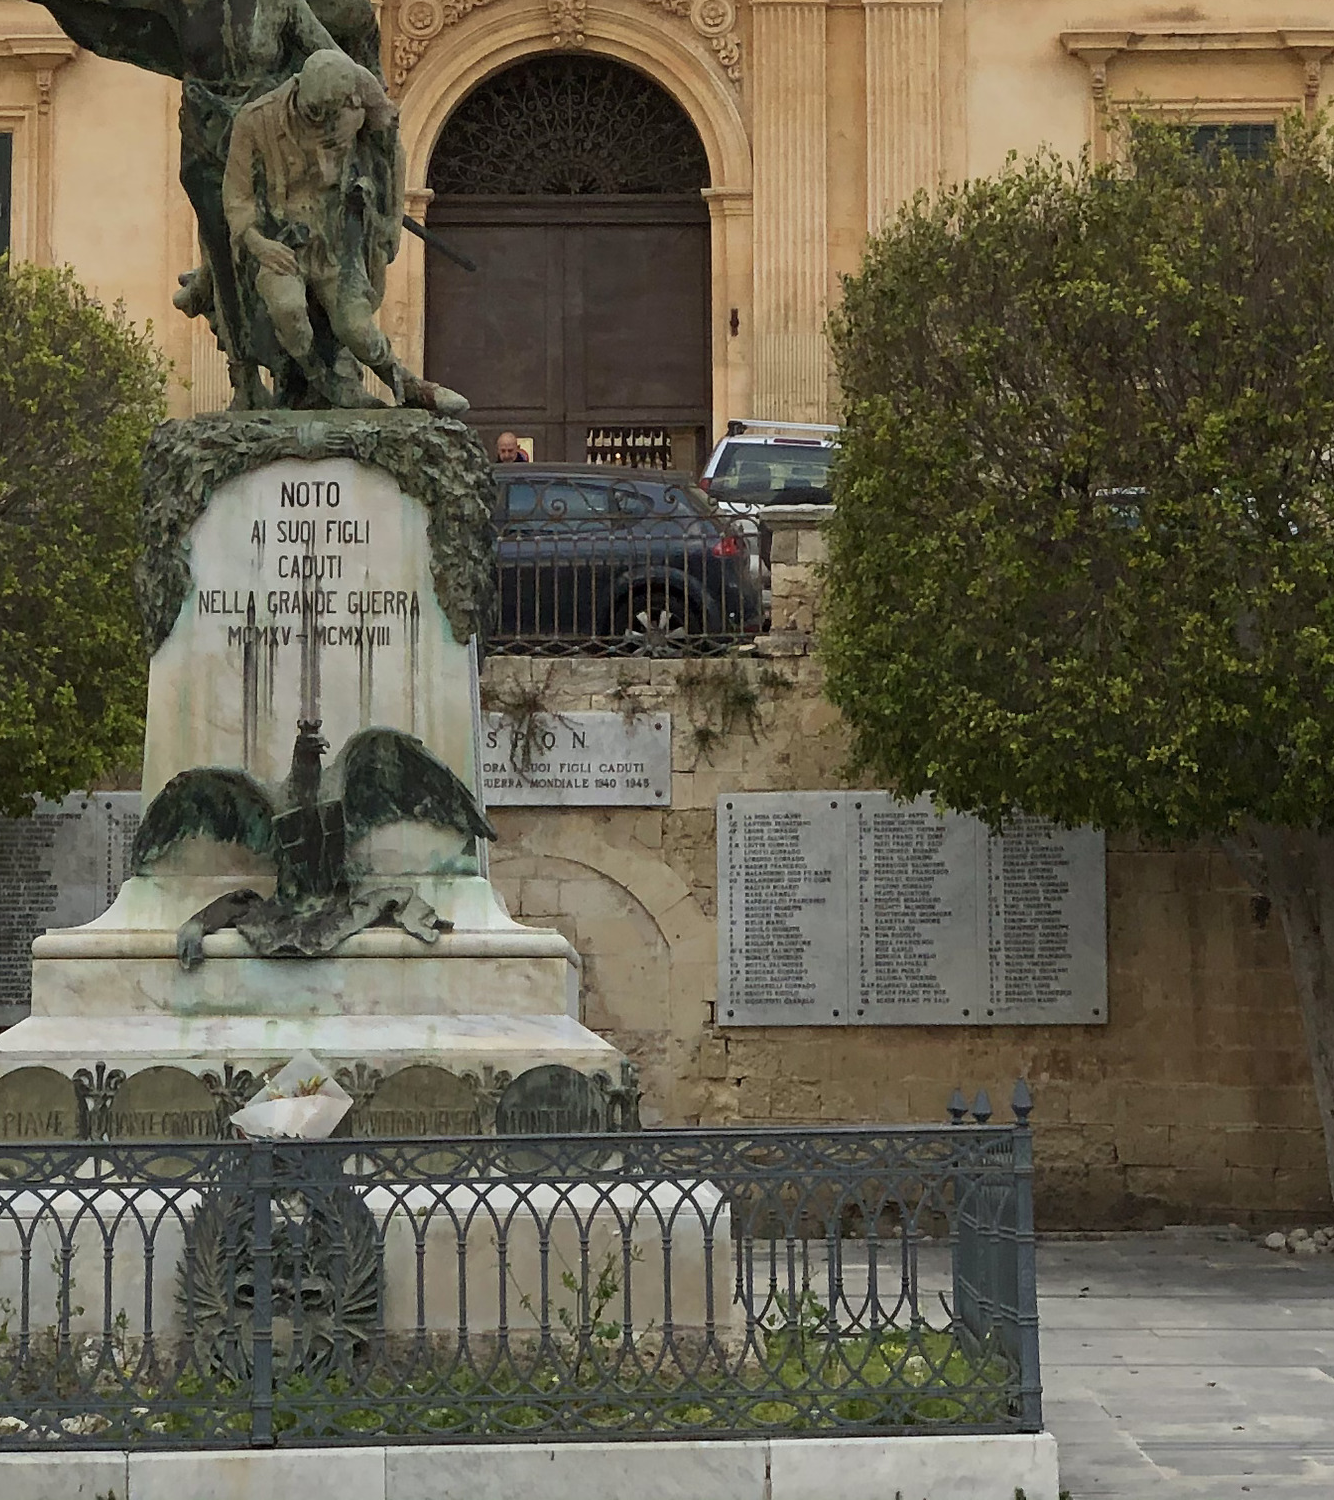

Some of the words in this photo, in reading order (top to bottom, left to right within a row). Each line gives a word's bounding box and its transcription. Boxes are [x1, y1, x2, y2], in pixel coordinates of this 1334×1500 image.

[280, 481, 341, 508] NOTO
[250, 520, 266, 544] AI
[276, 519, 316, 544] SUOI
[326, 519, 370, 544] FIGLI
[278, 555, 342, 579] CADUTI
[198, 590, 256, 615] NELLA
[267, 590, 337, 614] GRANDE
[347, 590, 420, 615] GUERRA
[227, 626, 291, 647] MCMXV
[314, 625, 391, 647] MCMXVIII
[559, 762, 591, 773] FIGLI
[598, 762, 644, 773] CADUTI
[529, 778, 589, 789] MONDIALE
[2, 1111, 65, 1137] PIAVE
